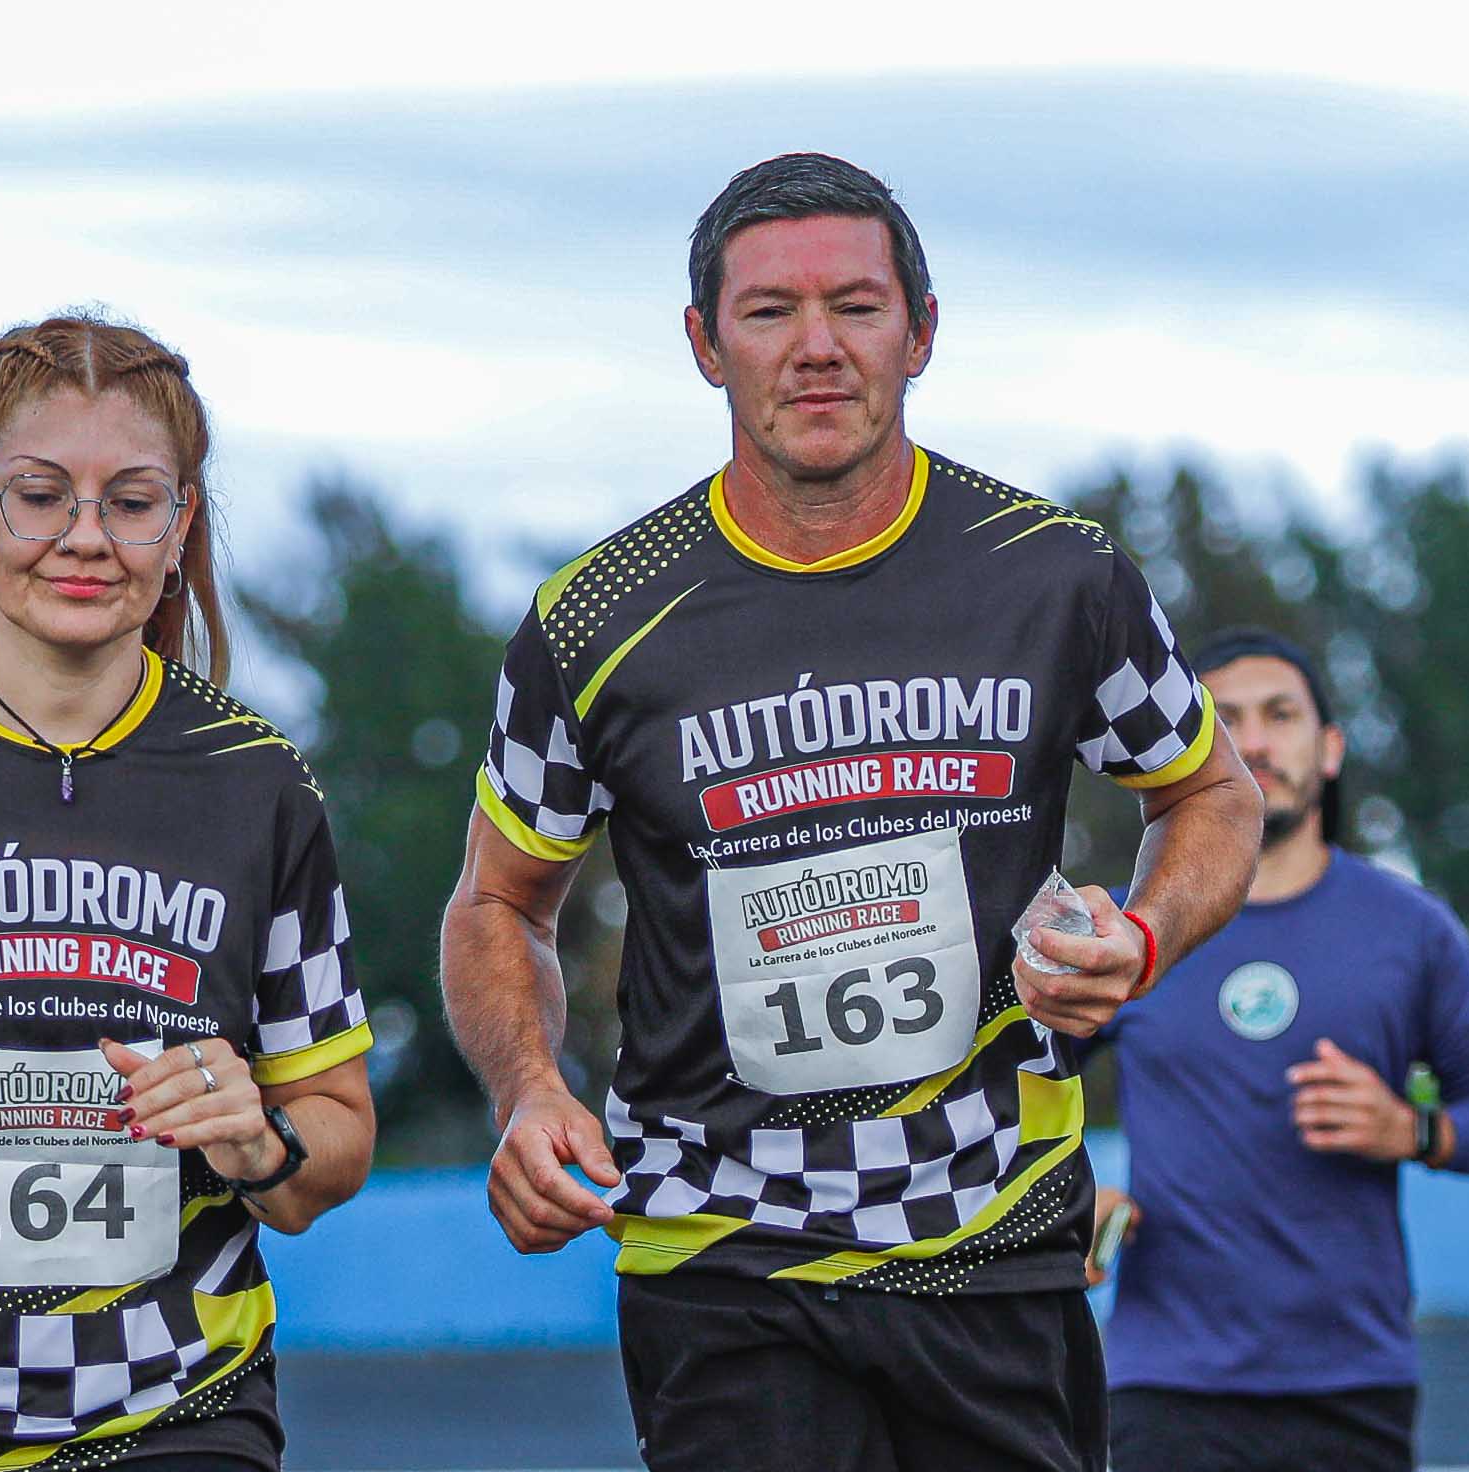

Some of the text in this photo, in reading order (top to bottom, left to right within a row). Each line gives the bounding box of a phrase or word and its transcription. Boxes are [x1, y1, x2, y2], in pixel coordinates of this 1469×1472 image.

[678, 672, 1032, 783] AUTÓDROMO
[735, 757, 978, 819] RUNNING RACE
[711, 834, 781, 858] Carrera
[786, 826, 810, 846] de
[815, 823, 843, 842] los
[847, 815, 915, 837] Clubes
[920, 809, 950, 830] del
[741, 862, 929, 929] AUTÓDROMO
[749, 924, 937, 968] La Carrera de los Clubes del Noroeste
[776, 905, 902, 946] RUNNING RACE
[91, 940, 171, 992] RACE
[8, 995, 36, 1016] los
[41, 996, 108, 1017] Clubes
[113, 999, 143, 1020] del
[146, 1004, 219, 1036] Noroeste
[764, 956, 945, 1056] 163
[14, 1135, 31, 1146] los
[33, 1136, 70, 1146] Clubes
[72, 1136, 90, 1146] del
[61, 1110, 108, 1128] RACE
